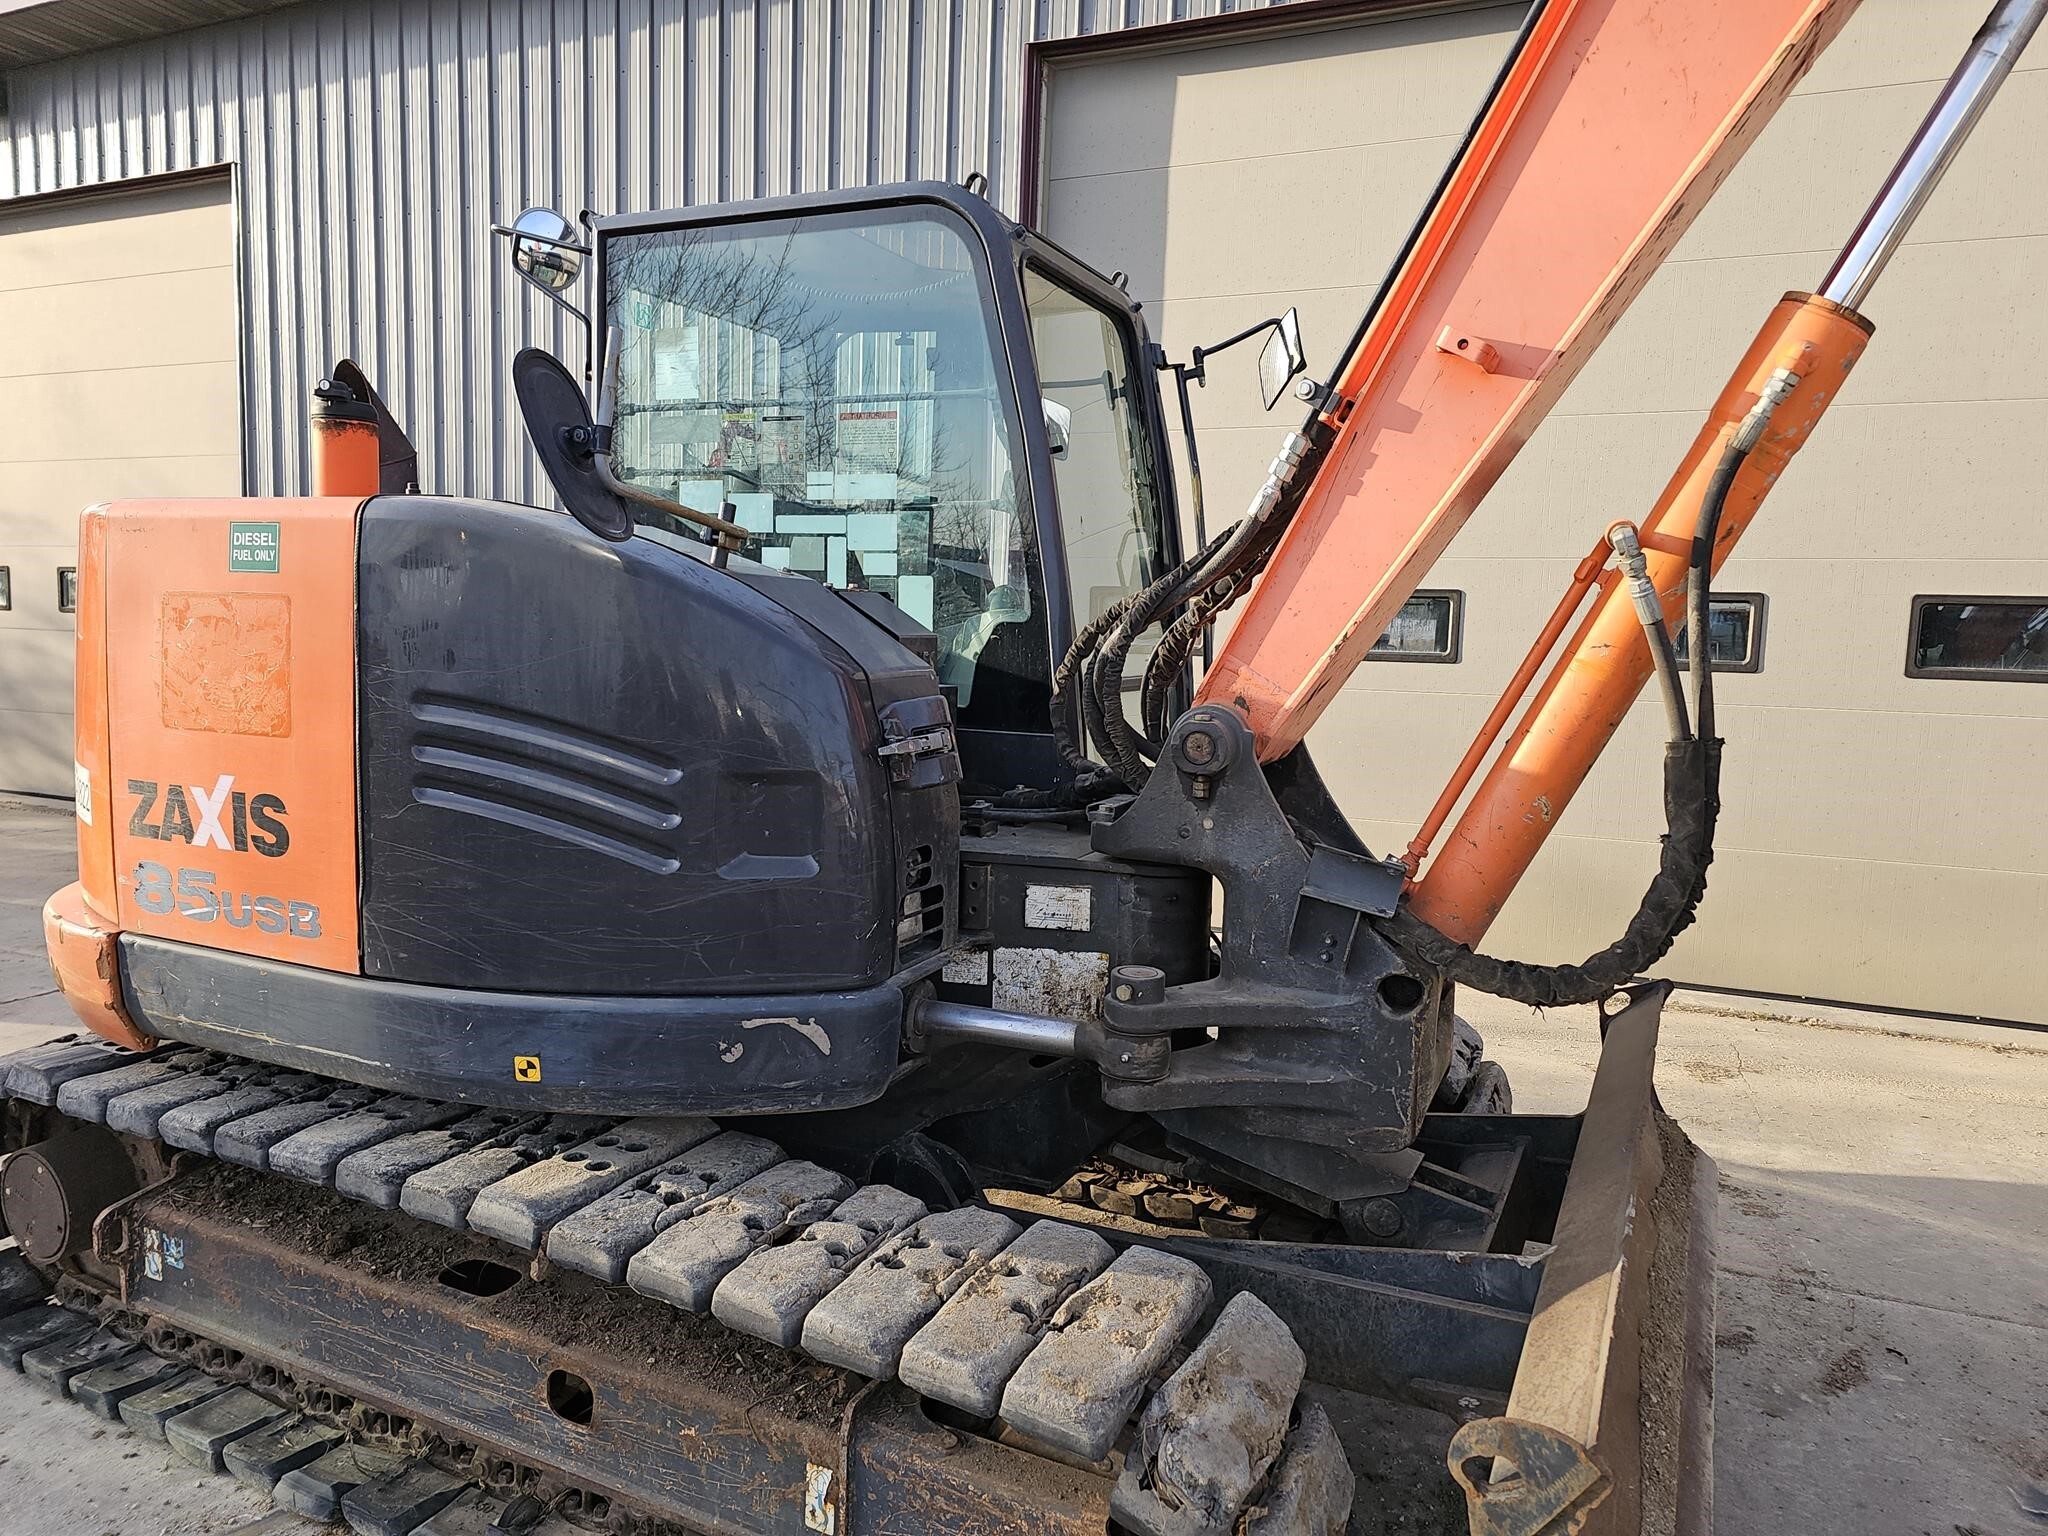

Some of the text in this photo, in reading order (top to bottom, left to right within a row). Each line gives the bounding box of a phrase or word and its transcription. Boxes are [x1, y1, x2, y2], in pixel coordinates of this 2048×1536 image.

[233, 532, 276, 546] DIESEL
[233, 549, 276, 561] FUEL ONLY
[128, 773, 289, 858] ZAXIS
[133, 860, 322, 938] 85USB
